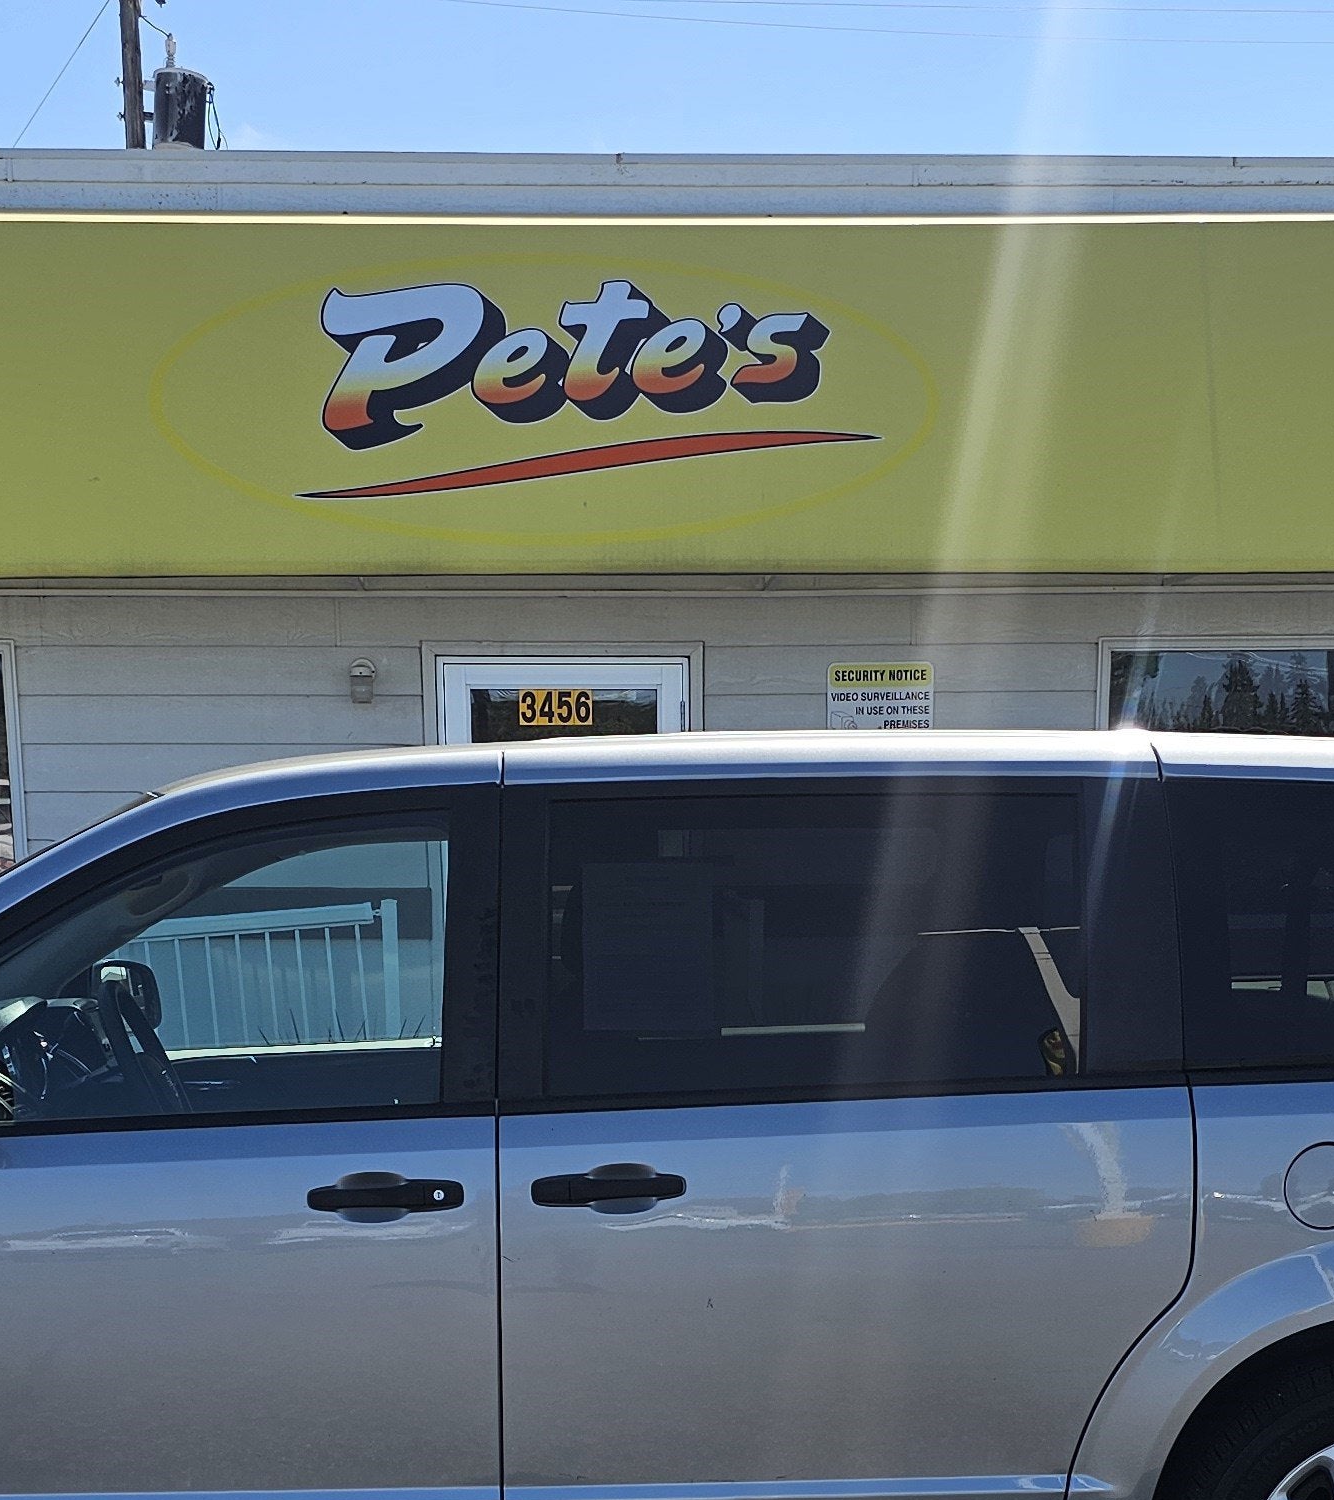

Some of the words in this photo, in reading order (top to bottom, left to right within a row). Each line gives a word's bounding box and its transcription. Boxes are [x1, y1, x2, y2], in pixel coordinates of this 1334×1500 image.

[319, 280, 832, 451] Pete's
[834, 669, 885, 682] SECURITY
[889, 669, 927, 681] NOTICE
[831, 692, 858, 702] VIDEO
[861, 691, 930, 701] SURVEILLANCE
[520, 690, 592, 724] 3456
[866, 706, 884, 715] USE
[886, 706, 899, 715] ON
[901, 705, 930, 715] THESE
[883, 719, 930, 729] PREMISES
